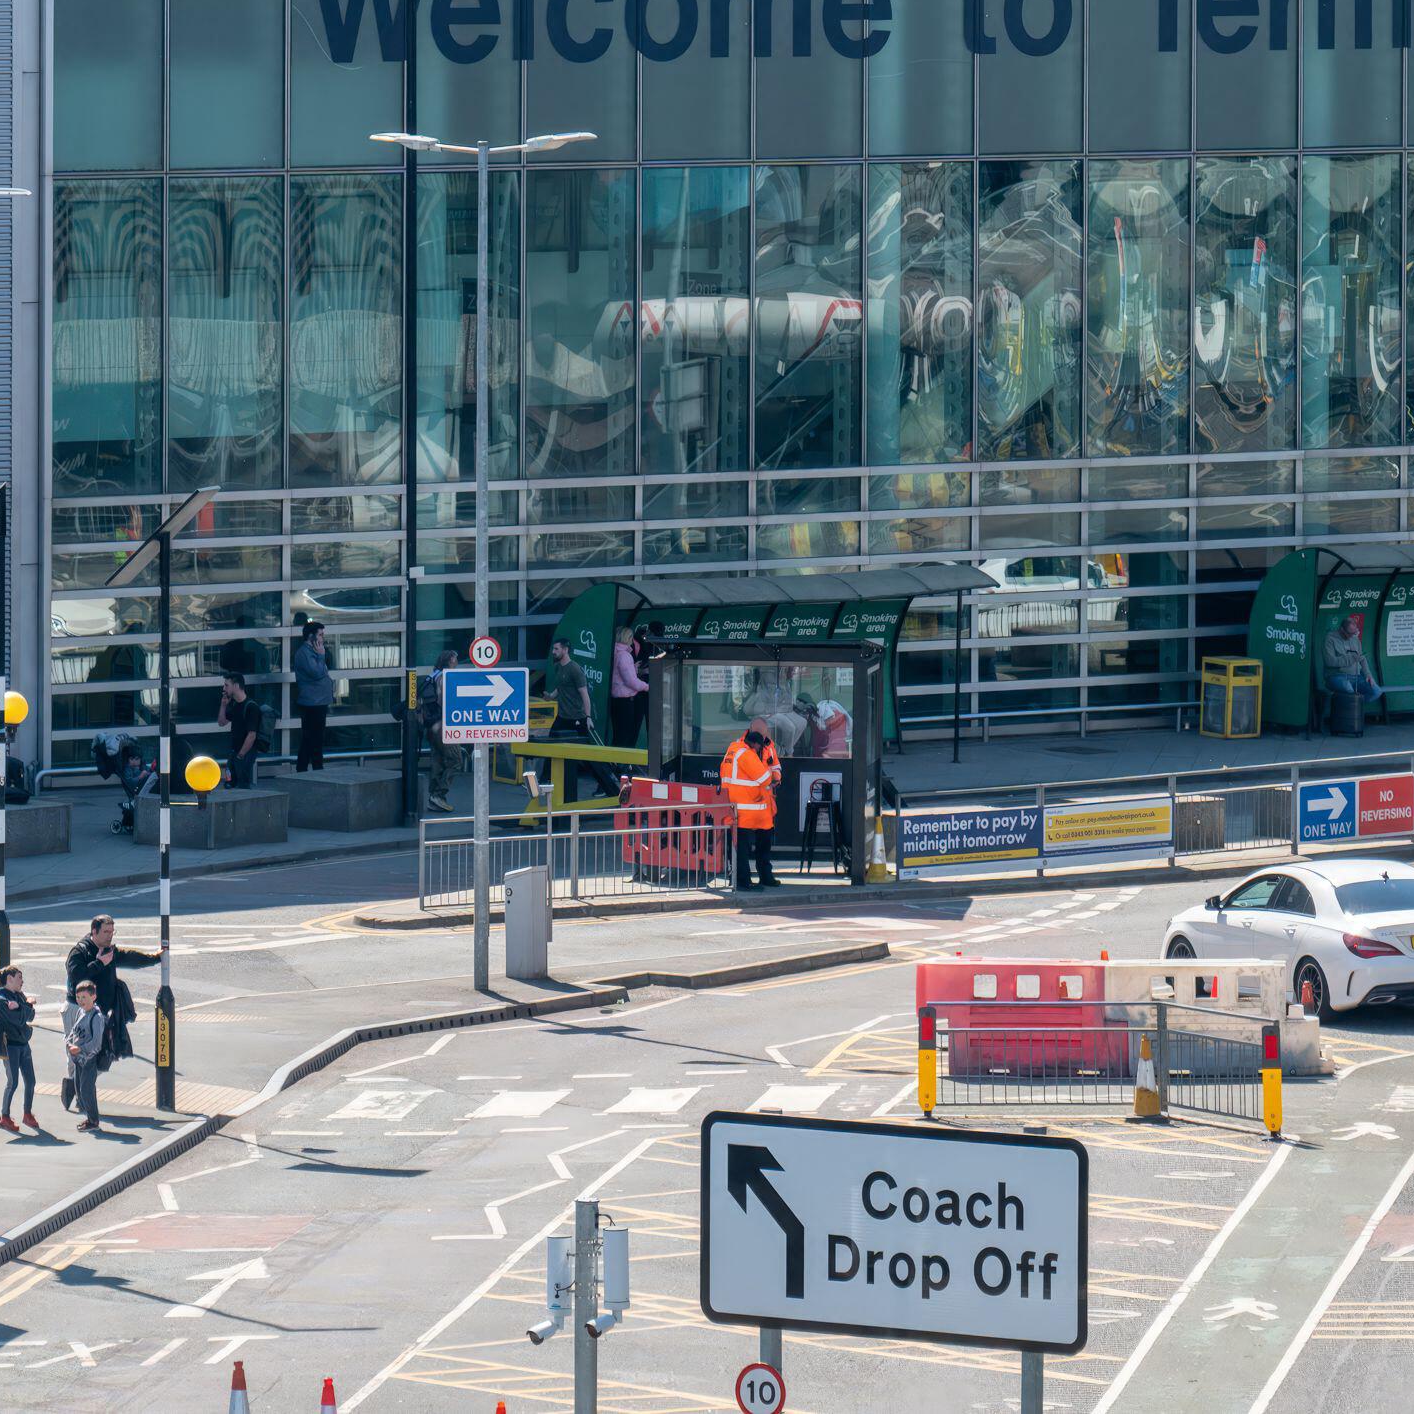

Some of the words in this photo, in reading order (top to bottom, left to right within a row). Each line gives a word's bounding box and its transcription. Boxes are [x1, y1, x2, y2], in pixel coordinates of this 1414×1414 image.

[1344, 589, 1380, 600] Smoking
[1350, 599, 1368, 607] area
[791, 617, 829, 628] Smoking
[860, 613, 898, 624] Smoking
[723, 620, 760, 631] Smoking
[797, 628, 817, 636] area
[1266, 626, 1305, 644] Smoking
[477, 646, 495, 659] 10
[1275, 642, 1295, 654] area
[451, 710, 483, 722] ONE
[488, 709, 520, 722] WAY
[445, 730, 461, 739] NO
[466, 729, 526, 739] REVERSING
[702, 770, 719, 778] This
[1379, 790, 1394, 802] NO
[1361, 806, 1412, 822] REVERSING
[903, 815, 973, 835] Remember
[976, 816, 989, 830] to
[992, 815, 1017, 832] pay
[1021, 810, 1038, 830] by
[1303, 824, 1326, 838] ONE
[1329, 822, 1352, 835] WAY
[903, 833, 961, 854] midnight
[963, 831, 1027, 849] tomorrow
[159, 1012, 167, 1063] 3307B
[861, 1171, 1024, 1231] Coach
[828, 1234, 950, 1299] Drop
[974, 1246, 1059, 1300] Off
[746, 1380, 776, 1405] 10
